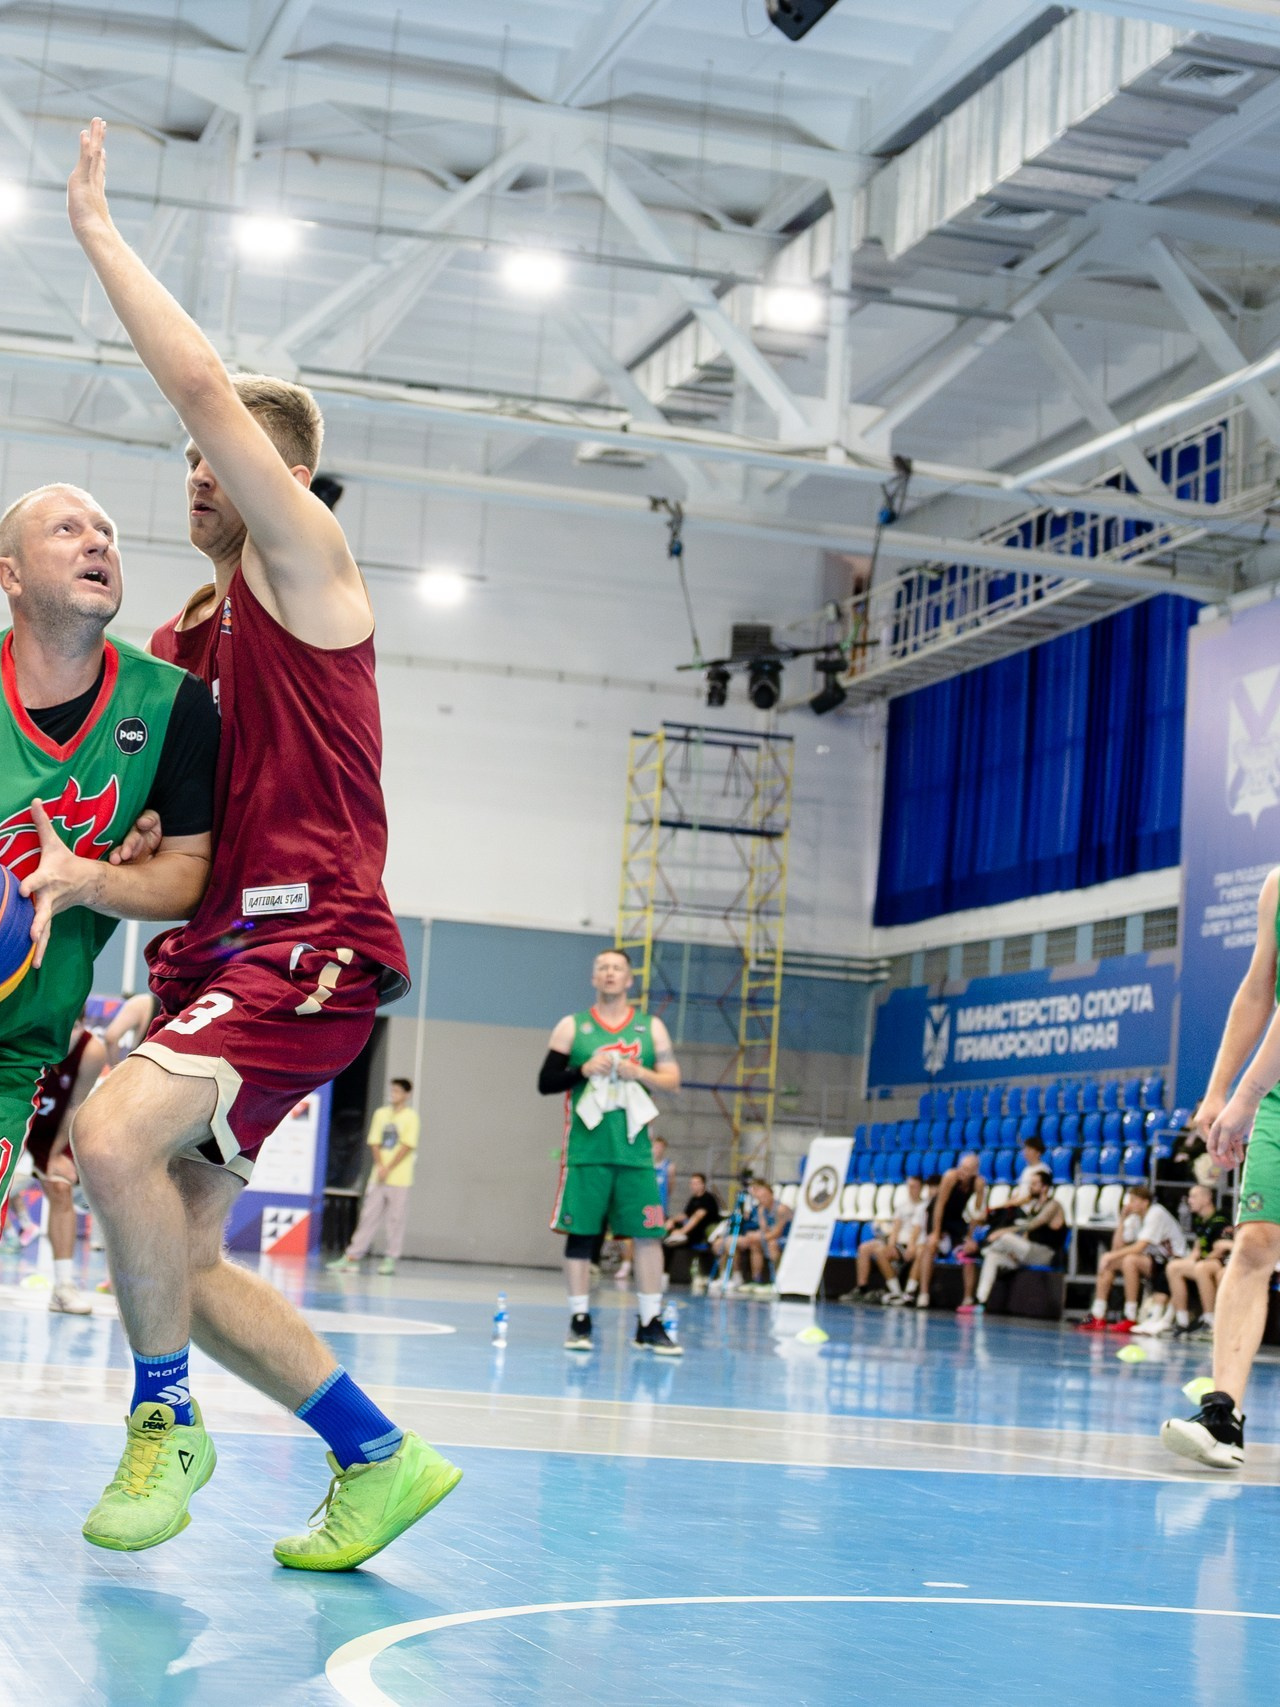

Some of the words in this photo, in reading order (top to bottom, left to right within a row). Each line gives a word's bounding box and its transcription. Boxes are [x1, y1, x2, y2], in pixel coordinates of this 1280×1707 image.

[119, 729, 144, 742] РФБ
[248, 895, 283, 908] NATIONAL
[284, 893, 303, 905] STAR
[163, 992, 234, 1036] 3
[956, 993, 1081, 1034] МИНИСТЕРСТВО
[1083, 983, 1155, 1020] СПОРТА
[954, 1026, 1069, 1063] ПРИМОРСКОГО
[1070, 1020, 1119, 1054] КРАЯ
[142, 1420, 169, 1431] PEAK
